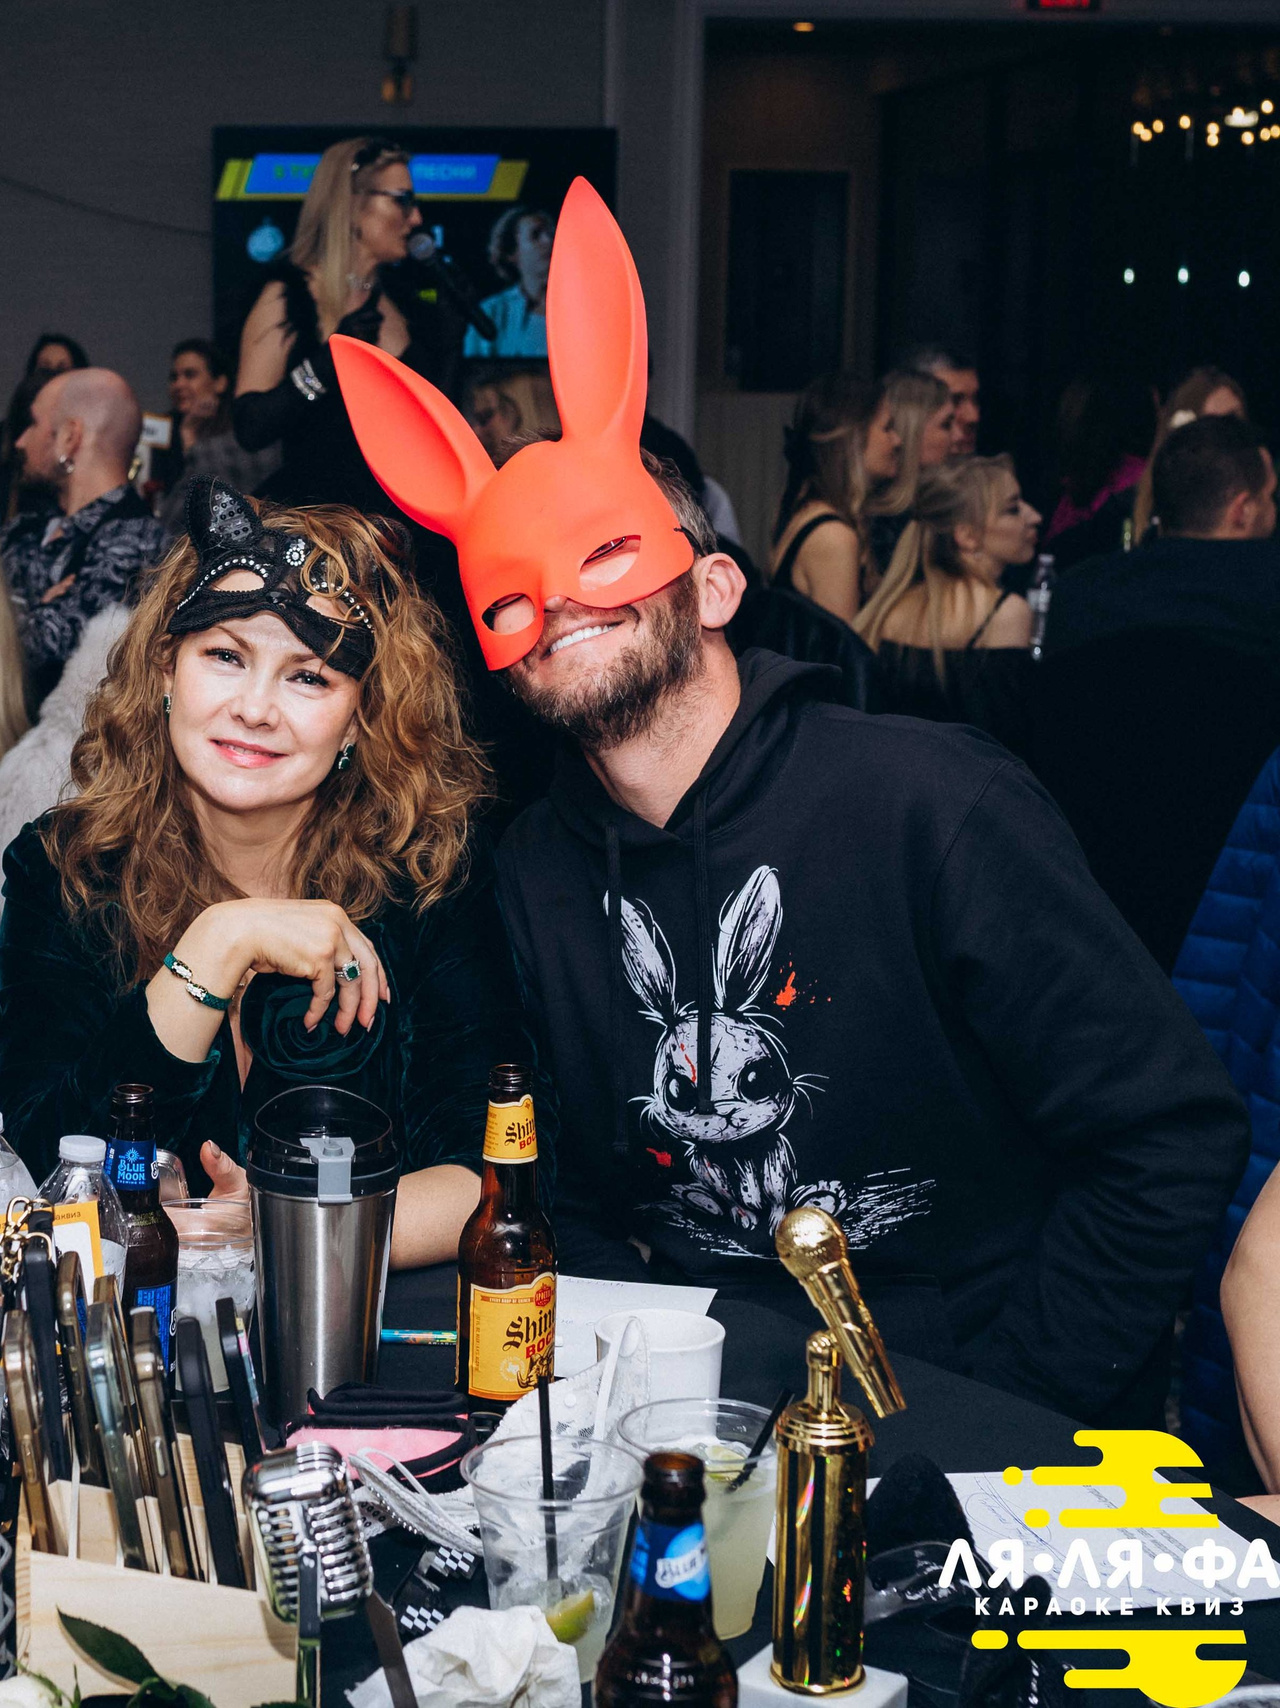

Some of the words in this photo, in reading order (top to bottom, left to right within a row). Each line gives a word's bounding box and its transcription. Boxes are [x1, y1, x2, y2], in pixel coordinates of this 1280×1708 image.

[519, 1132, 536, 1150] BOC
[117, 1159, 145, 1172] BLUE
[117, 1171, 146, 1181] MOON
[502, 1309, 556, 1351] Shin
[525, 1329, 556, 1359] BOC
